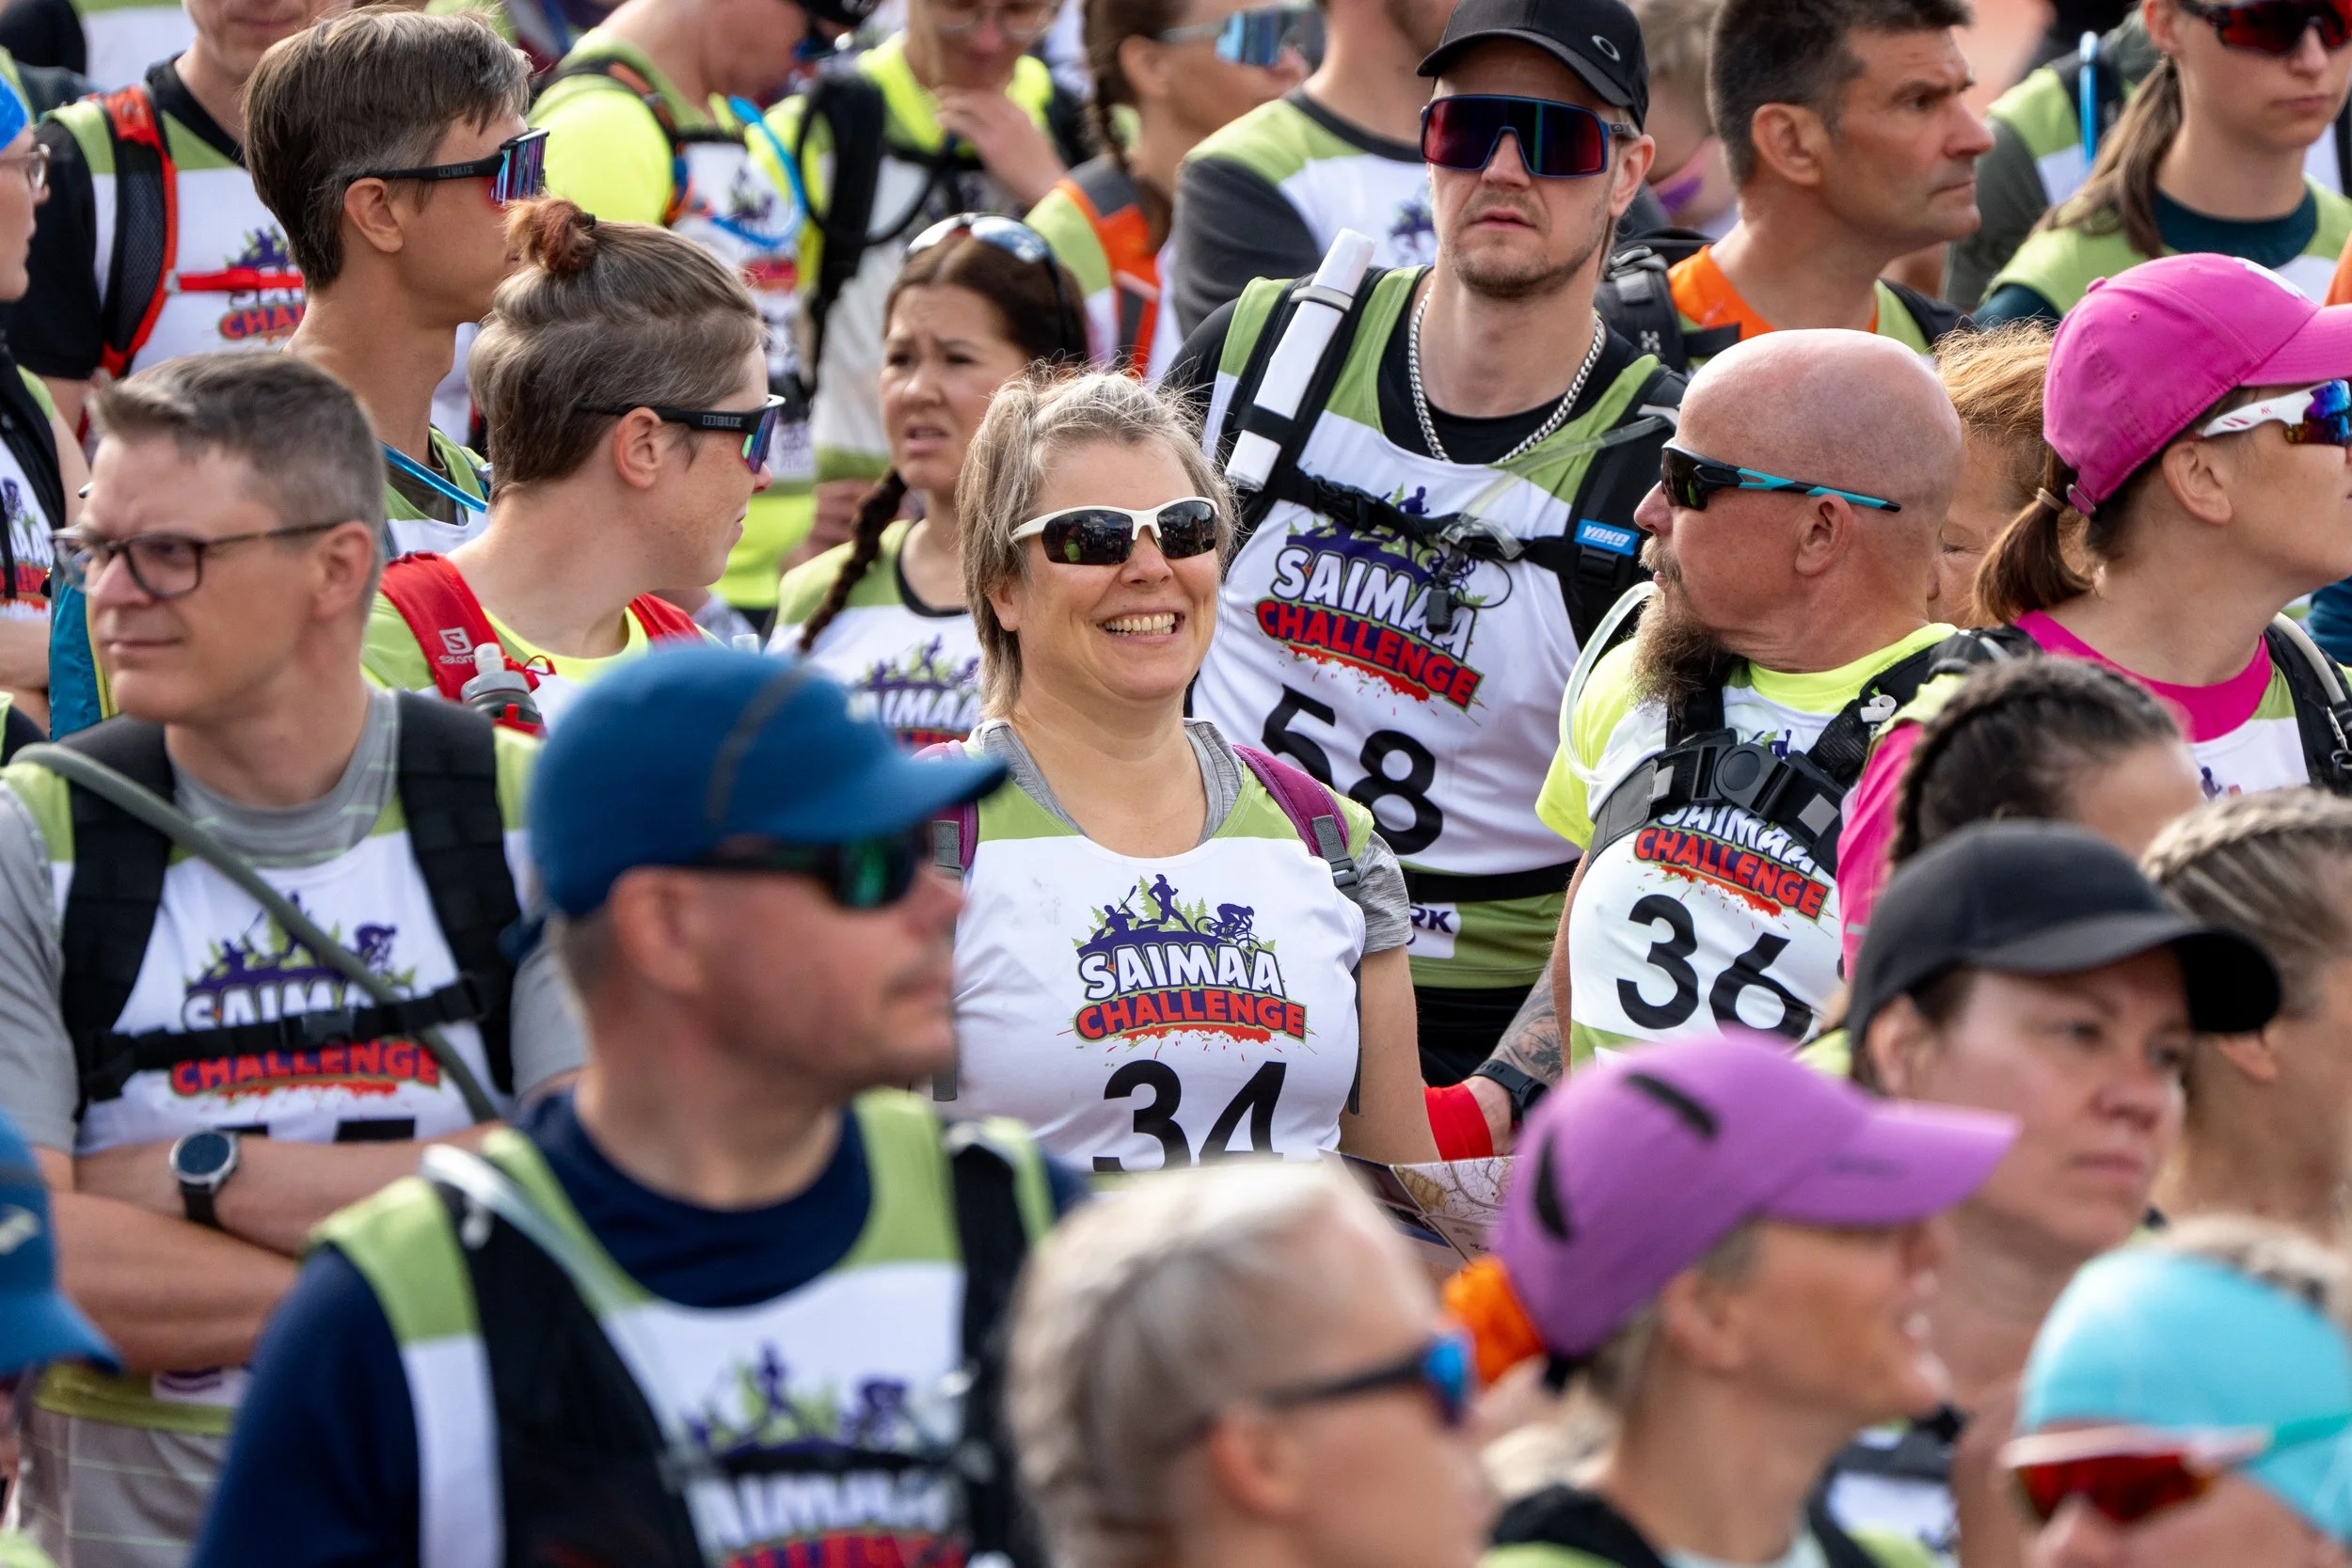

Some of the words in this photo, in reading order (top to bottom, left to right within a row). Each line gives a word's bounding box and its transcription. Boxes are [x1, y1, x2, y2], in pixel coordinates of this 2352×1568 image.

[1256, 599, 1480, 708] CHALLENGE
[1262, 683, 1443, 856] 58
[1635, 828, 1830, 920] CHALLENGE
[1076, 989, 1306, 1040] CHALLENGE
[1080, 942, 1286, 1000] SAIMAA
[1616, 894, 1814, 1047] 36
[171, 1037, 439, 1097] CHALLENGE
[1092, 1059, 1287, 1172] 34
